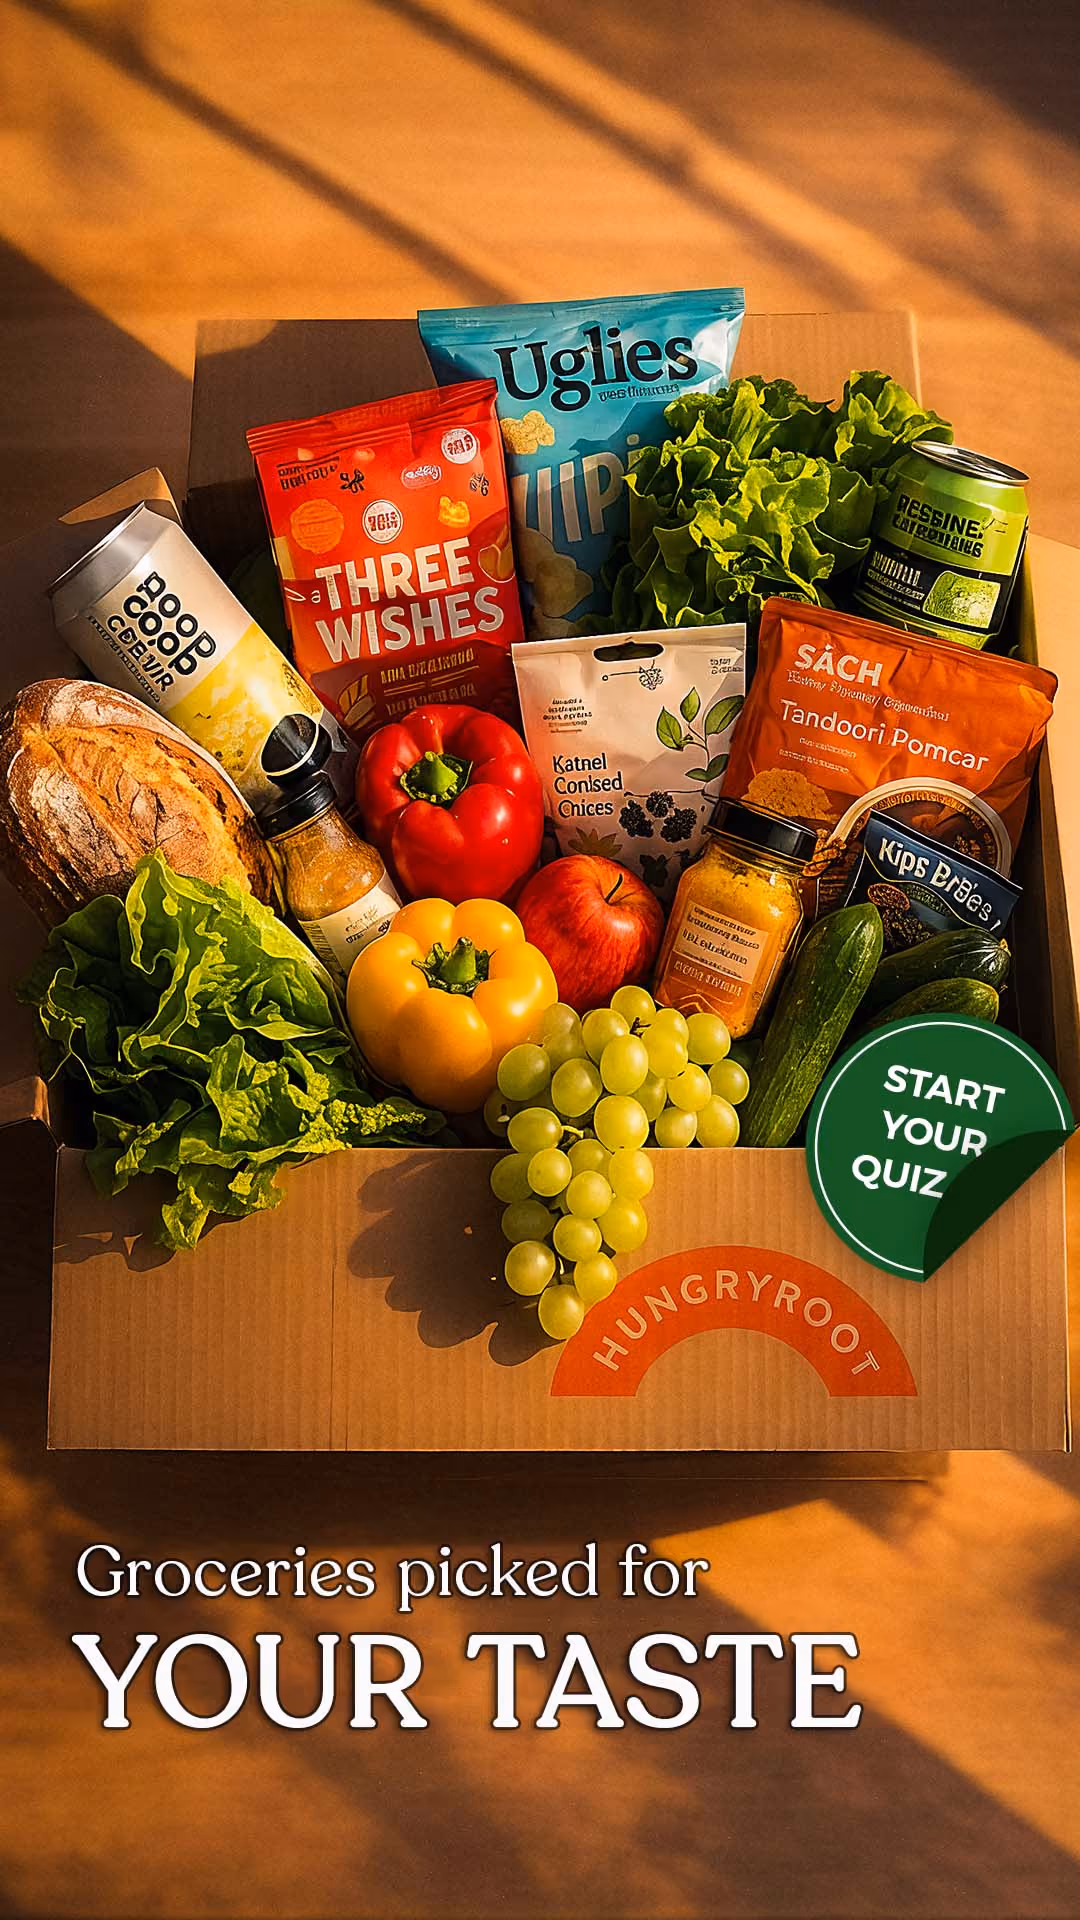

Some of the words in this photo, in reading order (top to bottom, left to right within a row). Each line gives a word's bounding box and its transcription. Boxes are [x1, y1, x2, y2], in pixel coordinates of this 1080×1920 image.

[494, 322, 699, 412] Uglies
[315, 536, 475, 611] THREE
[315, 586, 505, 664] WISHES
[780, 698, 886, 745] Tandoori
[890, 727, 991, 771] Pomcar
[878, 836, 931, 878] Kips
[592, 1269, 880, 1376] HUNGRYROOT
